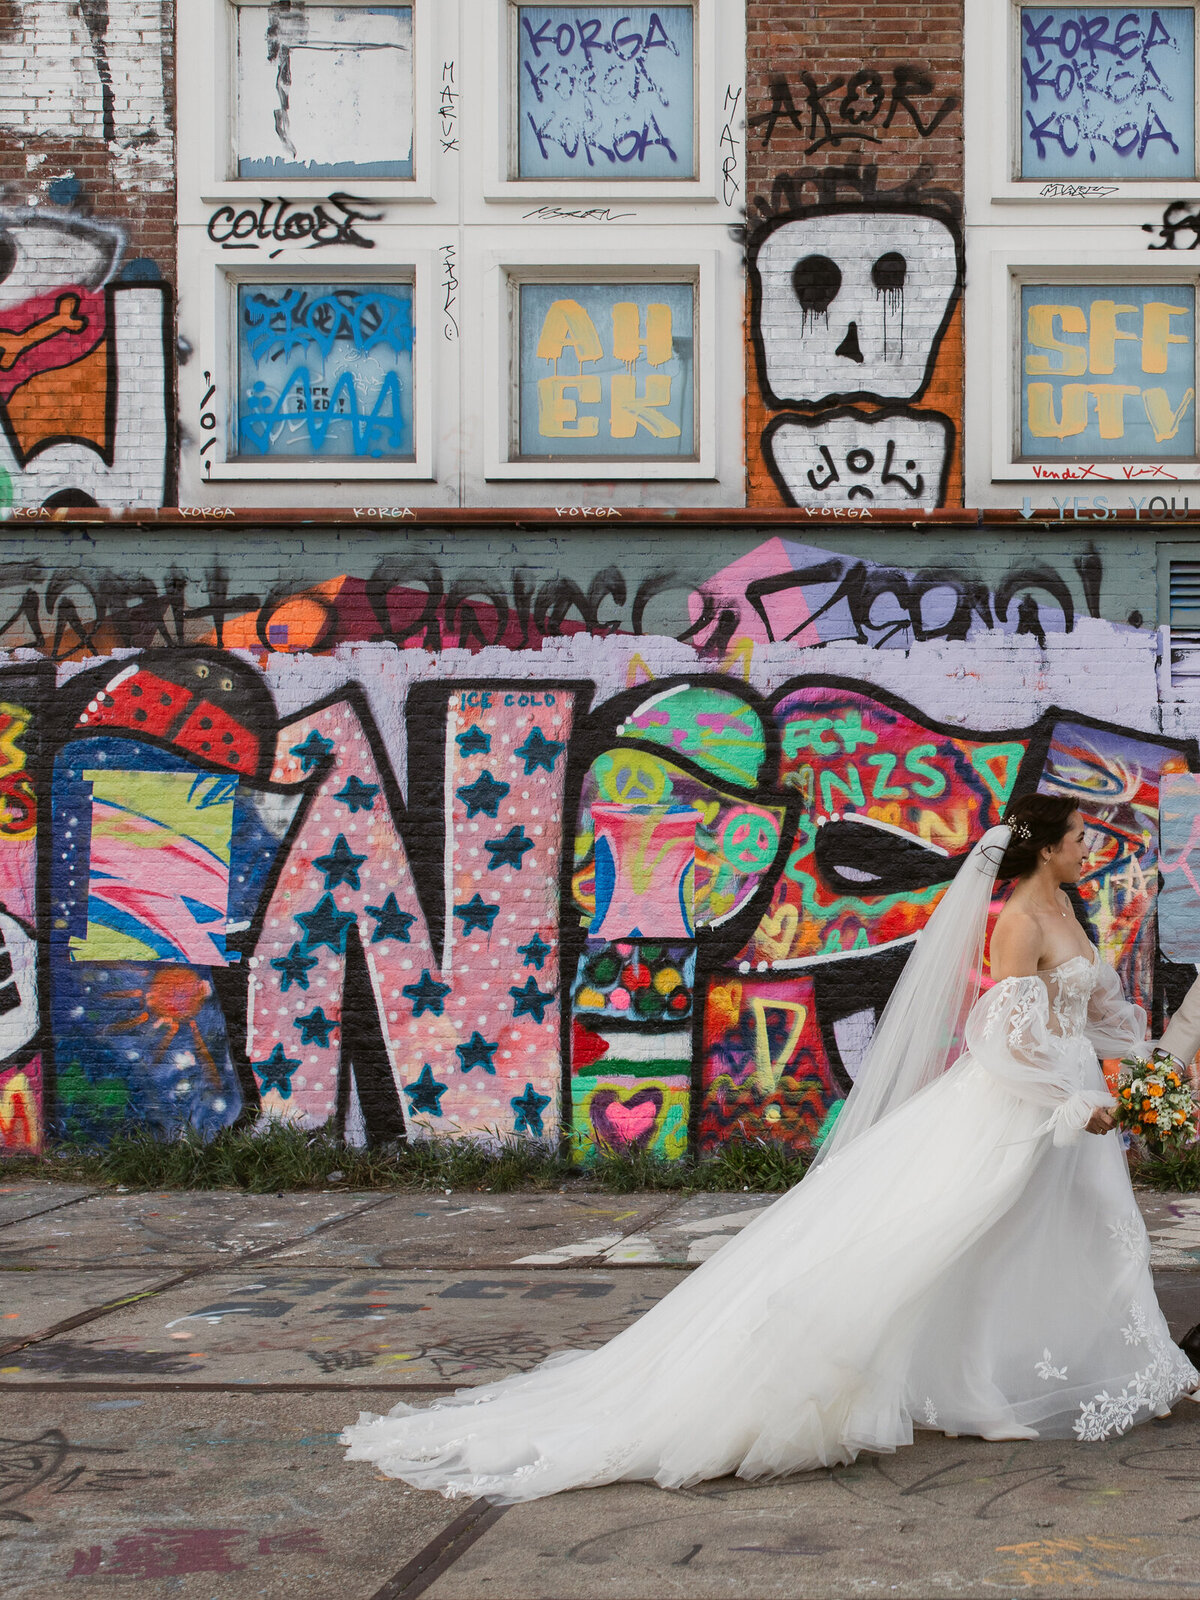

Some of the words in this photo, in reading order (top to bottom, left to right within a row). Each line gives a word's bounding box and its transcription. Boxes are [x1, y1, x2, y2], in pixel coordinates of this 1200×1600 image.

[538, 374, 682, 439] EK
[353, 507, 415, 519] KORGA
[555, 507, 622, 518] KORGA
[805, 507, 873, 519] KORGA
[1052, 496, 1118, 521] YES,
[1131, 496, 1190, 521] YOU
[461, 693, 492, 710] ICE
[504, 694, 556, 708] COLD
